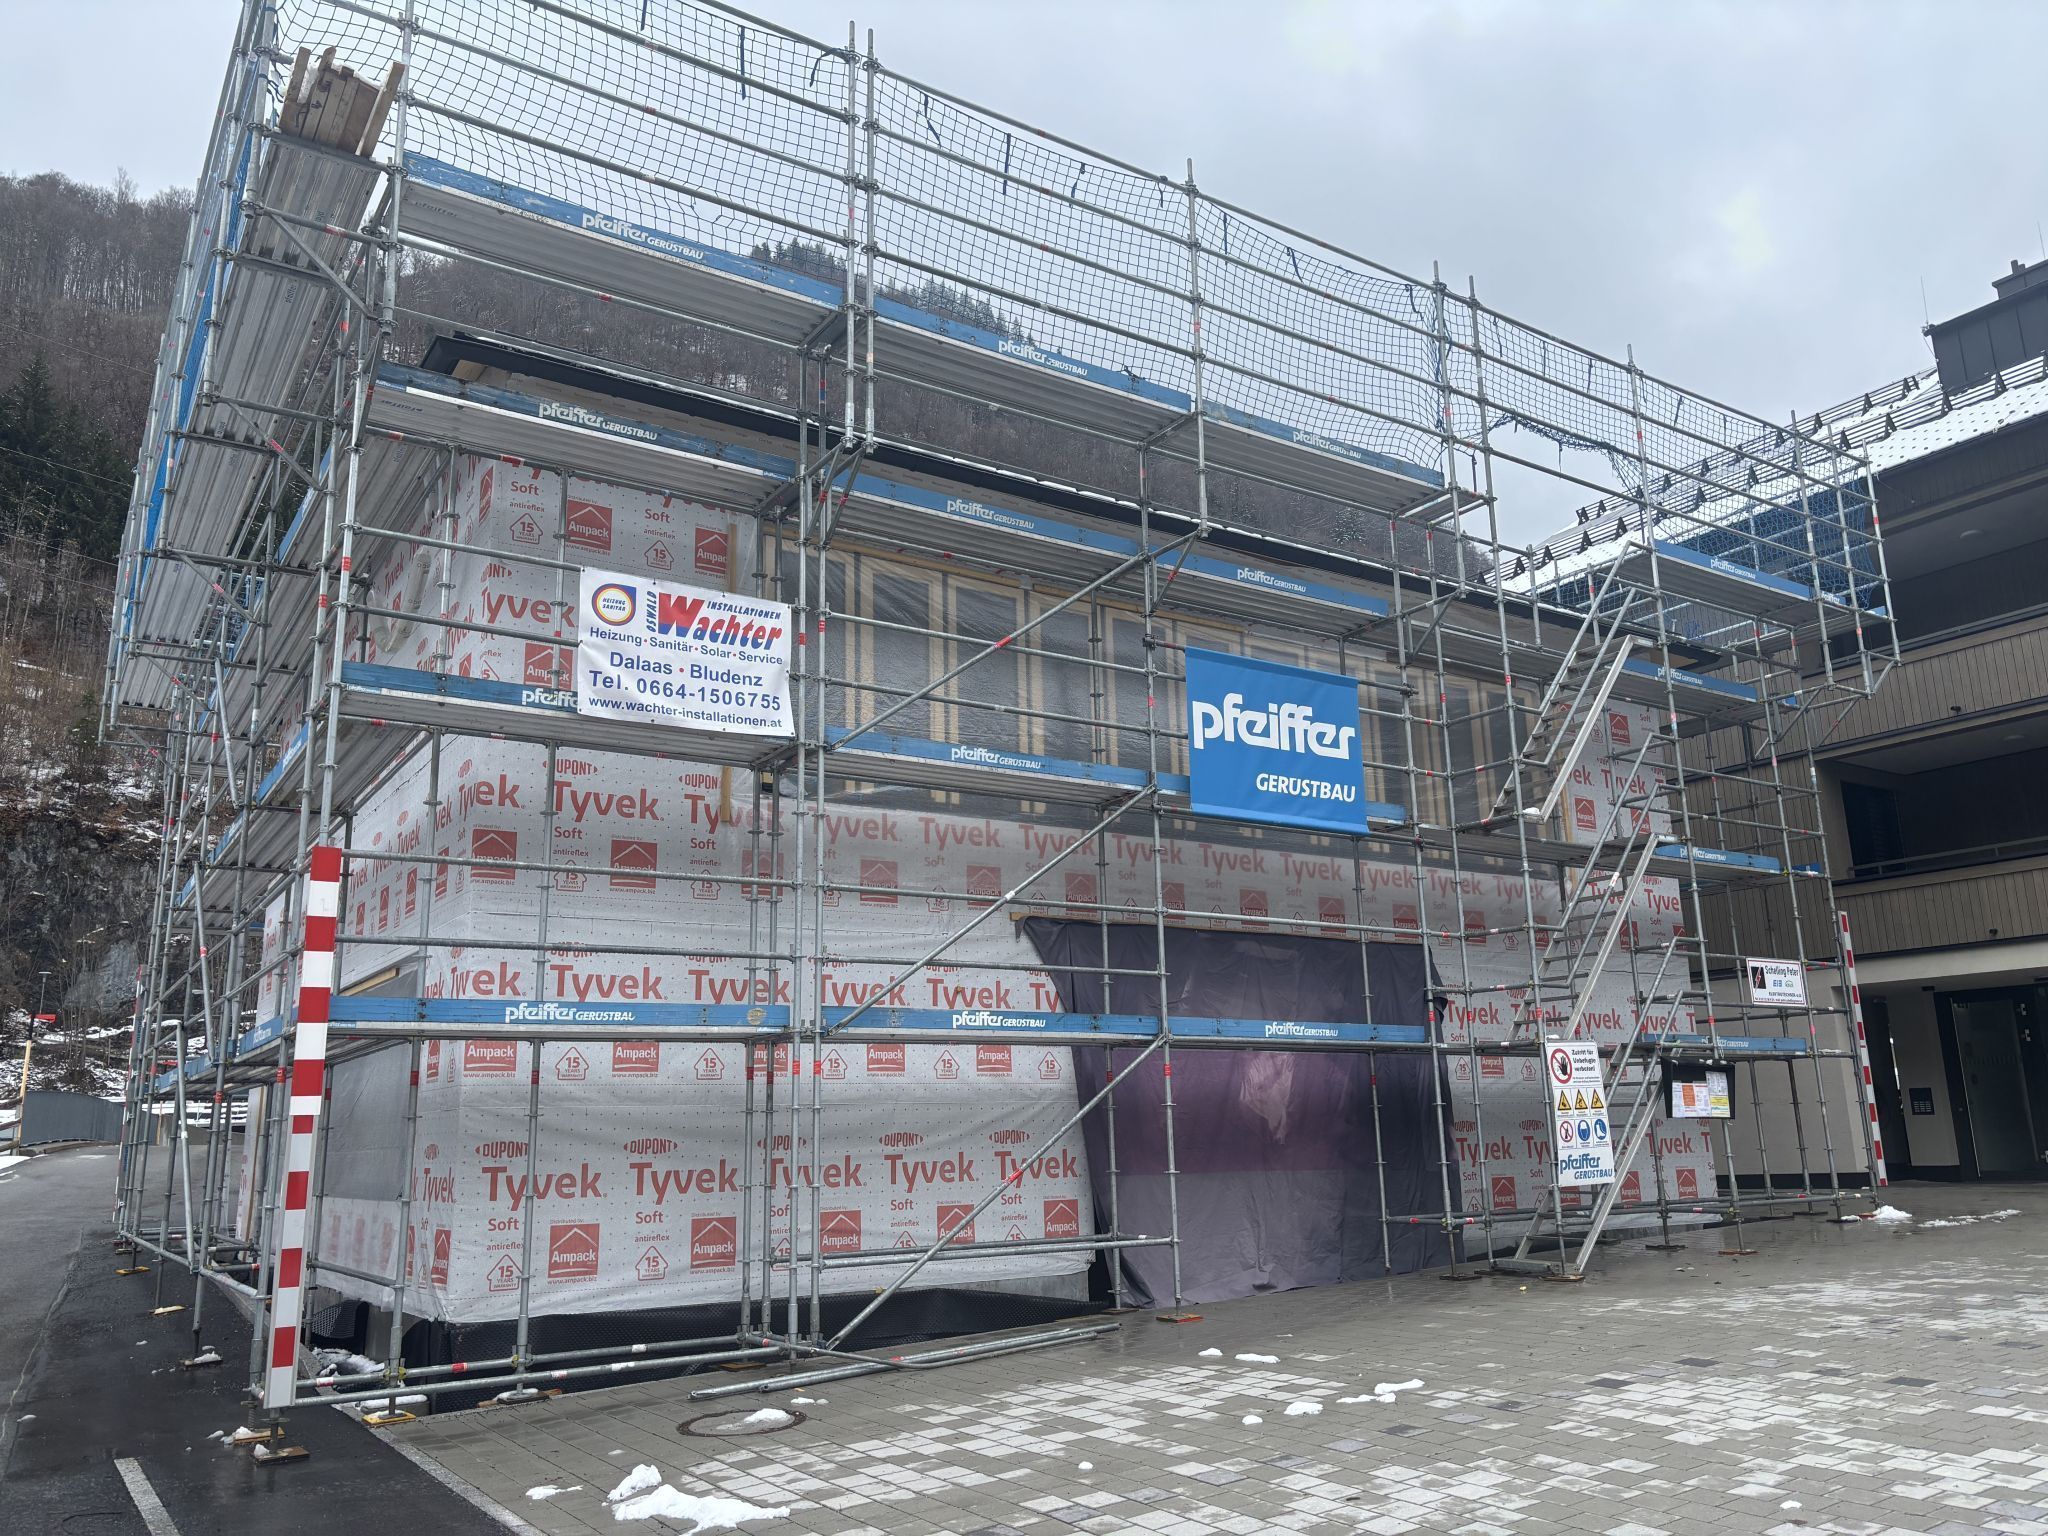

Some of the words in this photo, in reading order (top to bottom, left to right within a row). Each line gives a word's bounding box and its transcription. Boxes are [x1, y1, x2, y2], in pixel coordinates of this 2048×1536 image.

[582, 213, 649, 241] pfeiffer
[999, 339, 1048, 364] pfeiffer
[539, 401, 604, 428] pfeiffer
[1292, 430, 1331, 449] pfeiffer
[511, 480, 539, 496] Soft
[644, 508, 670, 524] Soft
[947, 499, 995, 521] pfeiffer
[520, 521, 534, 533] 15
[567, 519, 609, 539] Ampack
[652, 547, 667, 559] 15
[696, 548, 727, 564] Ampac
[1237, 567, 1275, 584] pfeiffer
[602, 597, 627, 606] HEIZUNG
[646, 590, 657, 632] OSWALD
[706, 600, 781, 620] INSTALLATIONEN
[657, 592, 783, 650] Wachter
[589, 626, 642, 647] Heizung
[649, 636, 693, 653] Sanitär
[700, 645, 732, 659] Solar
[738, 650, 783, 665] Service
[610, 652, 673, 675] Dalaas
[690, 664, 764, 687] Bludenz
[589, 670, 629, 691] Tel.
[636, 678, 781, 711] 0664-1506755
[588, 697, 783, 728] www.wachter-installationen.at
[1191, 692, 1356, 760] pfeiffer
[951, 747, 1001, 766] pfeiffer
[1256, 773, 1356, 803] GERÜSTBAU
[554, 780, 660, 823] Tyvek
[554, 826, 583, 840] Soft
[918, 817, 1001, 851] Tyvek
[690, 838, 716, 850] Soft
[1111, 833, 1183, 868] Tyvek
[552, 848, 589, 858] antireflex
[1198, 843, 1266, 876] Tyvek
[1118, 870, 1137, 881] Soft
[1280, 852, 1344, 885] Tyvek
[549, 965, 663, 1003] Tyvek
[926, 978, 1012, 1010] Tyvek
[505, 1002, 577, 1024] pfeiffer
[952, 1011, 1004, 1029] pfeiffer
[1265, 1021, 1306, 1037] pfeiffer
[467, 1044, 515, 1059] Ampack
[615, 1046, 657, 1060] Ampack
[868, 1049, 904, 1062] Ampack
[978, 1049, 1010, 1062] Ampack
[565, 1057, 580, 1068] 15
[703, 1058, 717, 1068] 15
[828, 1058, 840, 1068] 15
[941, 1058, 953, 1068] 15
[1044, 1059, 1056, 1069] 15
[463, 1071, 516, 1079] www.ampack.biz
[884, 1132, 919, 1147] DUPONT
[994, 1129, 1027, 1145] DUPONT
[630, 1138, 672, 1154] DUPONT
[994, 1148, 1078, 1188] Tyvek
[1559, 1153, 1601, 1174] pfeiffer
[884, 1151, 975, 1193] Tyvek
[1463, 1172, 1478, 1181] Soft
[1530, 1169, 1544, 1178] Soft
[1574, 1168, 1613, 1180] GERÜSTBAU
[423, 1167, 455, 1212] Tyvek
[481, 1162, 602, 1212] Tyvek
[629, 1158, 739, 1205] Tyvek
[890, 1199, 914, 1211] Soft
[1000, 1193, 1022, 1205] Soft
[487, 1217, 519, 1231] Soft
[635, 1211, 664, 1224] Soft
[1046, 1221, 1078, 1234] Ampack
[634, 1234, 670, 1243] antireflex
[822, 1234, 859, 1248] Ampack
[692, 1241, 734, 1256] Ampack
[551, 1249, 597, 1266] Ampack
[645, 1256, 660, 1267] 15
[499, 1265, 514, 1278] 15
[548, 1276, 597, 1285] www.ampack.biz
